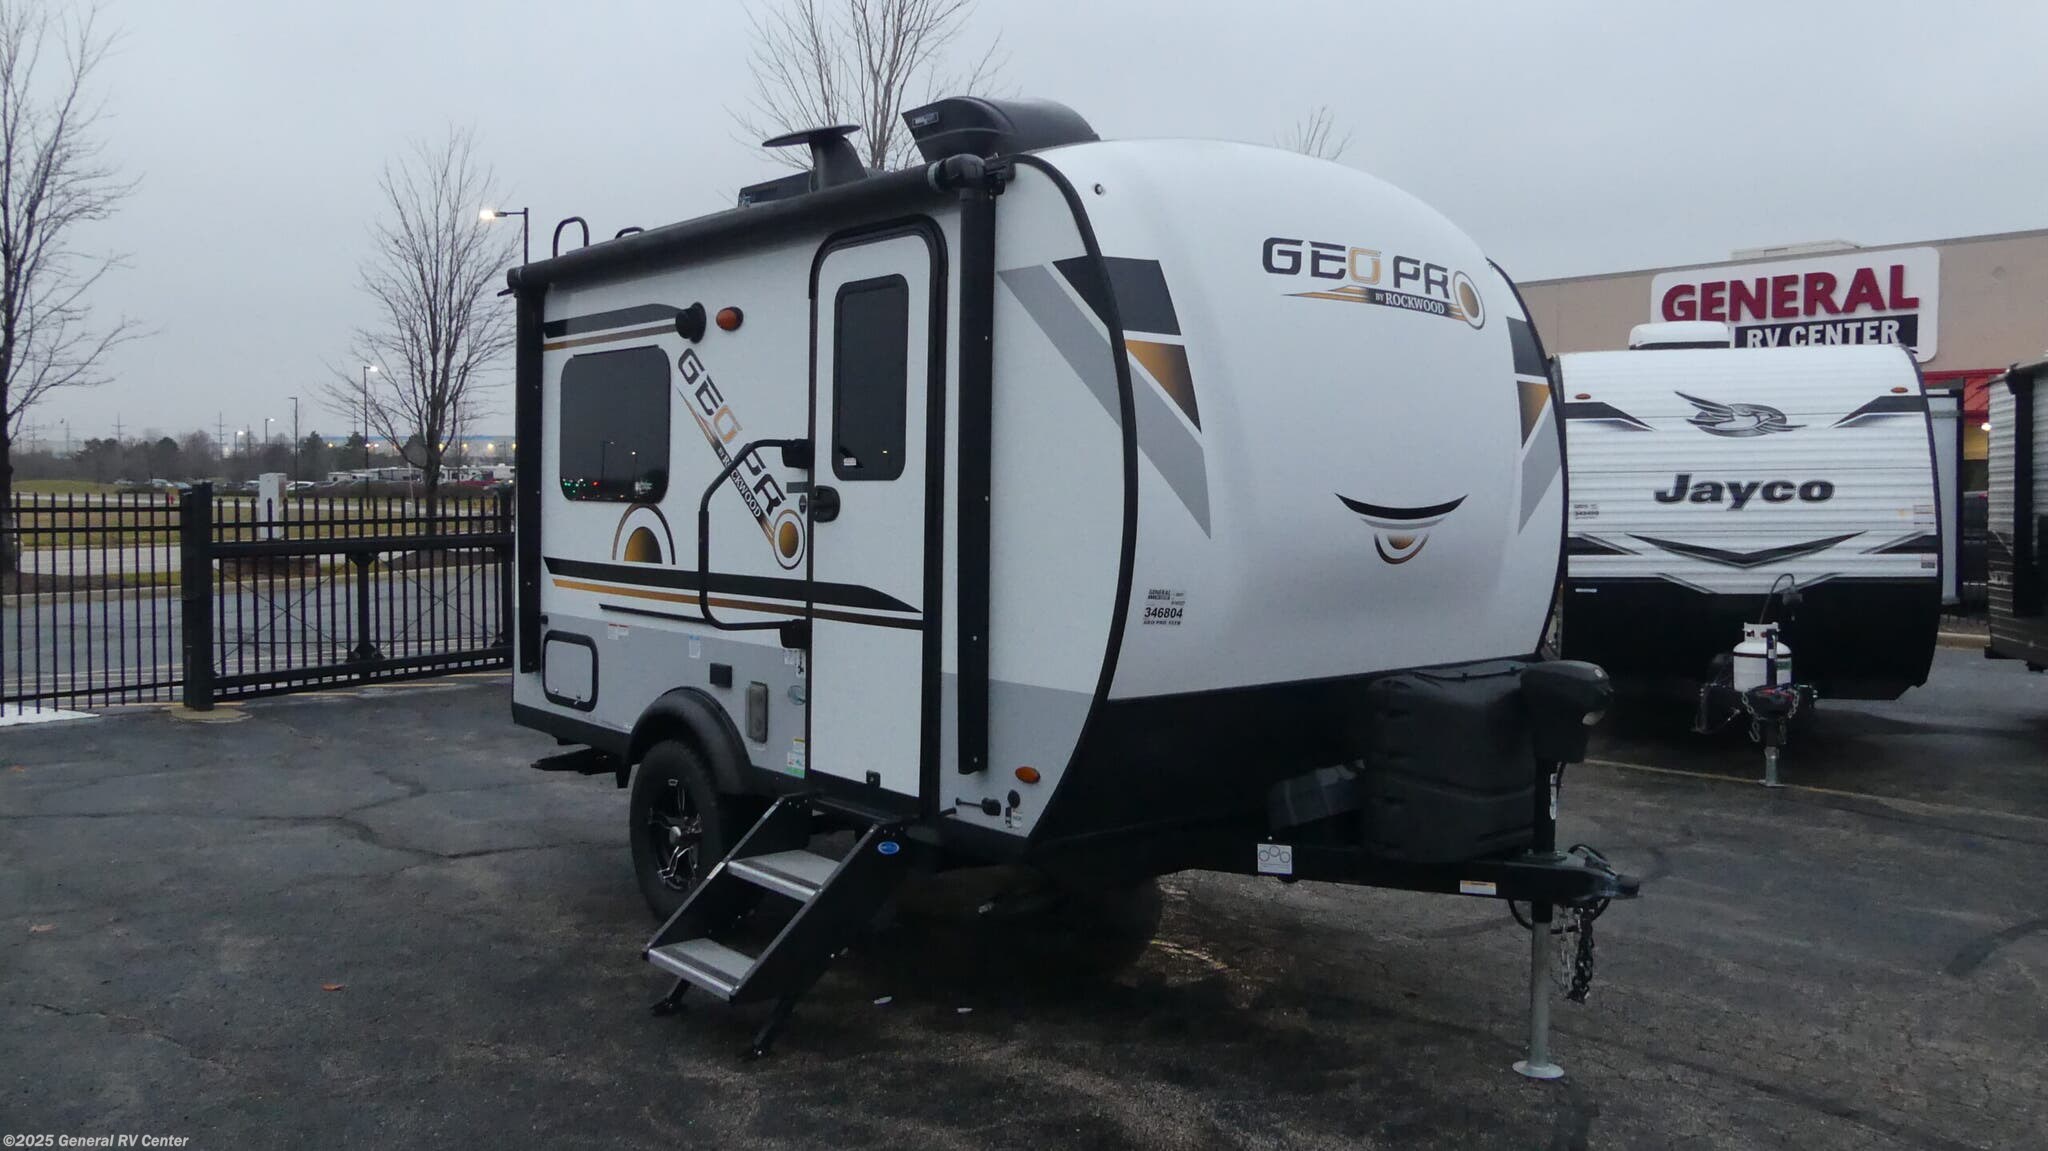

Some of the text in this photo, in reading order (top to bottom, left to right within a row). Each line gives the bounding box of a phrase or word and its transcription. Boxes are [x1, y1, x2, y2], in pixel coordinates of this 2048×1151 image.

[1262, 237, 1486, 330] GEO PRO
[1375, 291, 1445, 315] BY ROCKWOOD
[1661, 264, 1919, 322] GENERAL
[1746, 320, 1900, 348] RV CENTER
[677, 348, 743, 444] GEO
[723, 456, 762, 518] RCKWOOD
[1653, 472, 1836, 512] Jayco
[1144, 606, 1183, 619] 346804
